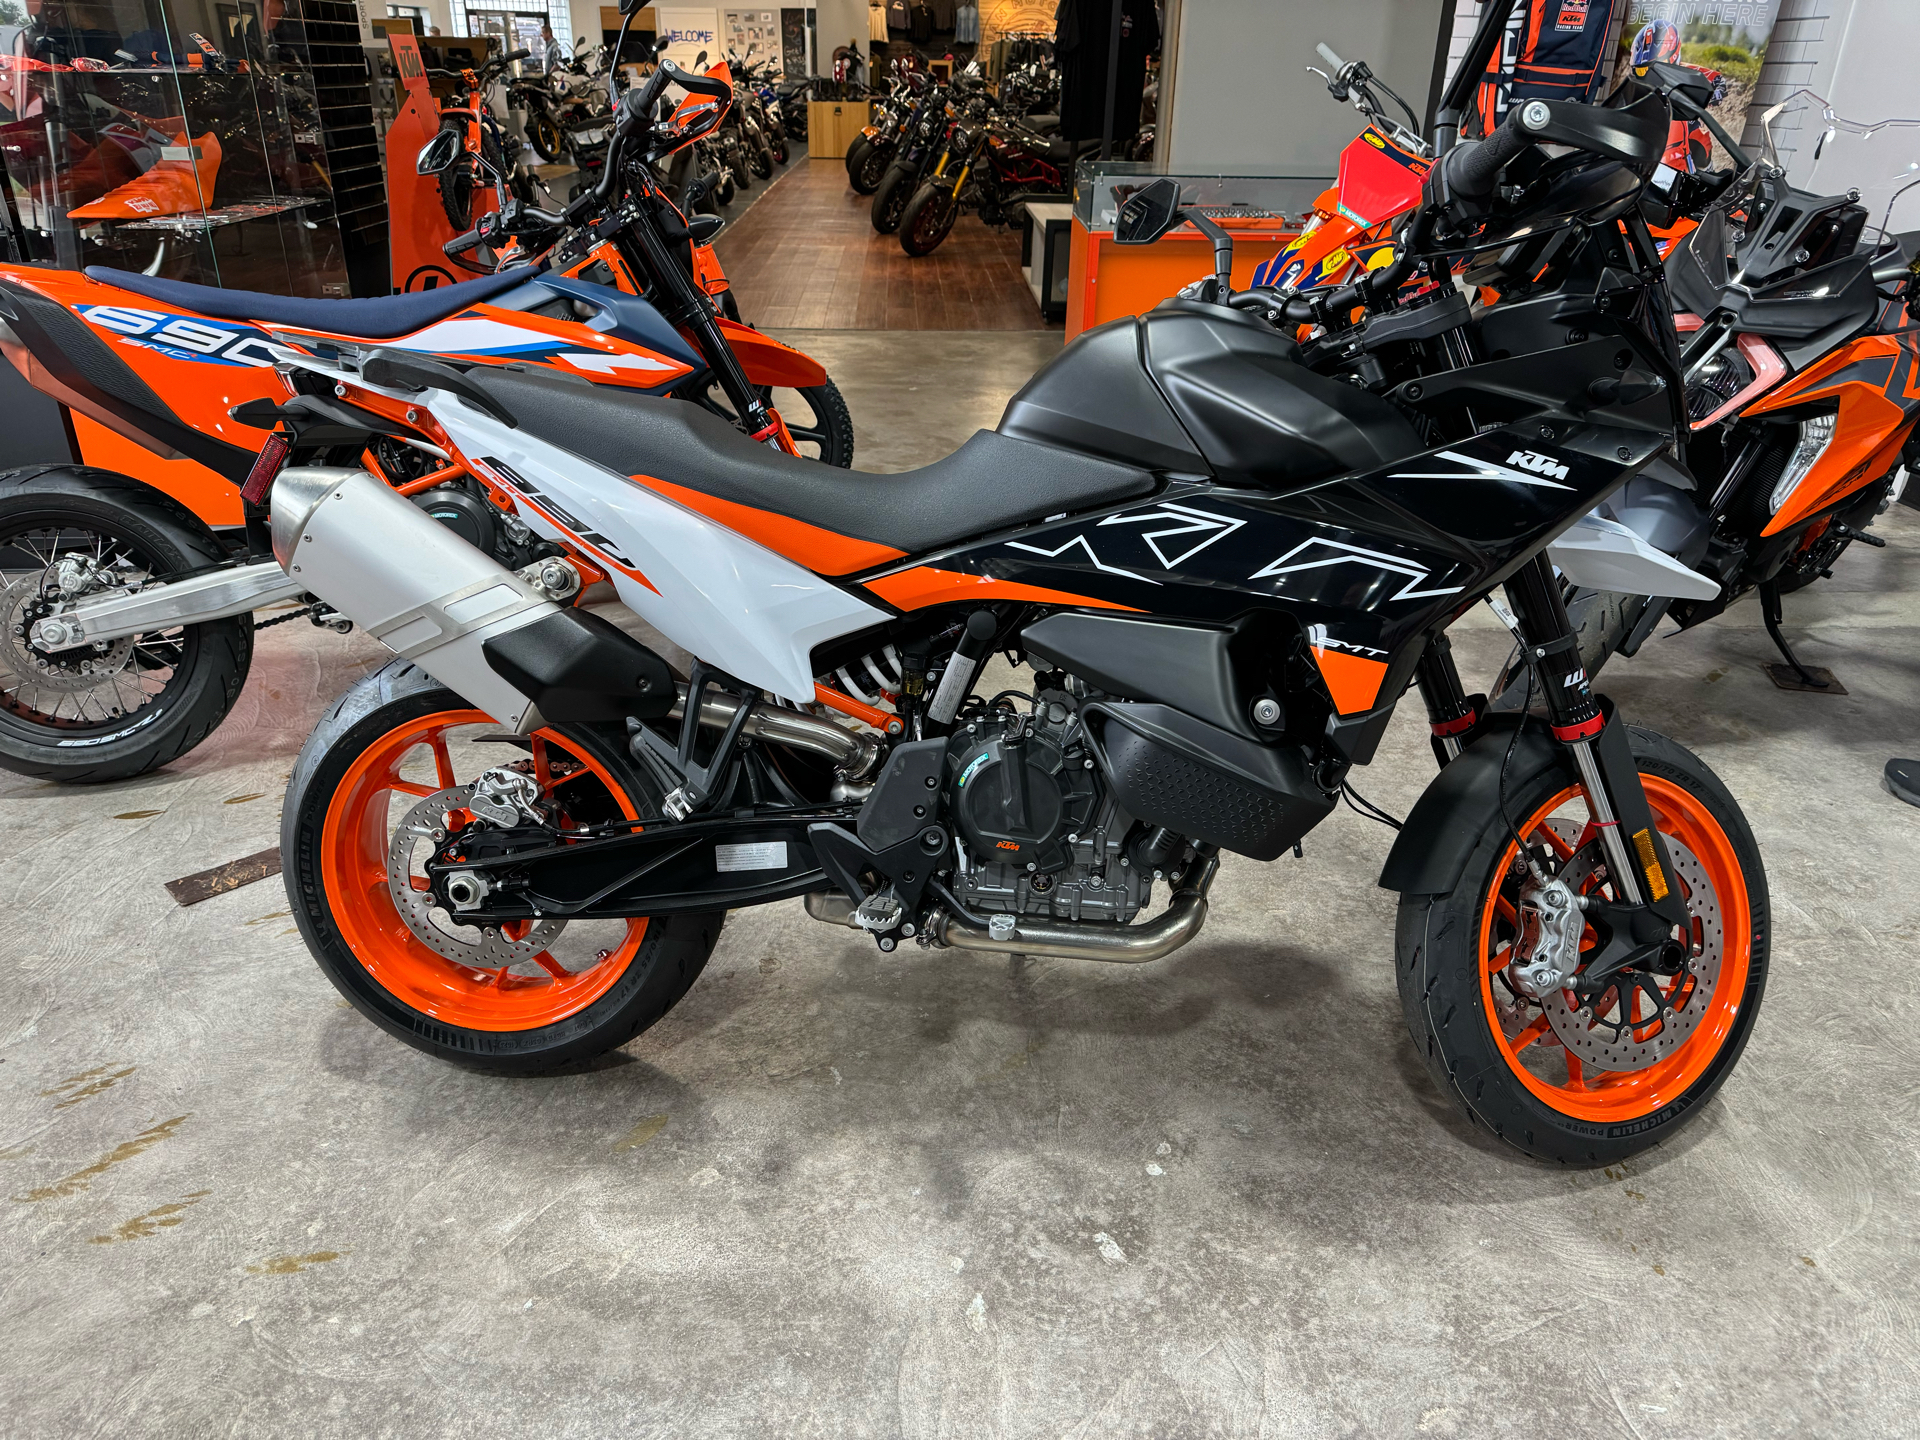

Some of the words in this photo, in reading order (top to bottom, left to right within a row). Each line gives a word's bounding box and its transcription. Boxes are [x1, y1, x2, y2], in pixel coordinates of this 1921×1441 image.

[1627, 3, 1697, 25] BEGIN
[1701, 3, 1769, 27] HERE
[664, 28, 714, 44] WELCOME
[82, 305, 278, 368] 690
[1505, 449, 1571, 481] KTM
[1314, 636, 1389, 657] SMT
[963, 754, 987, 779] MOTOREX
[1641, 760, 1676, 776] 120/70
[1675, 773, 1691, 783] ZR
[1689, 780, 1702, 790] 17
[306, 780, 326, 822] POWER
[995, 840, 1021, 852] KTM
[301, 829, 322, 917] MICHELIN
[1564, 1122, 1604, 1136] POWER
[1611, 1109, 1674, 1138] MICHELIN
